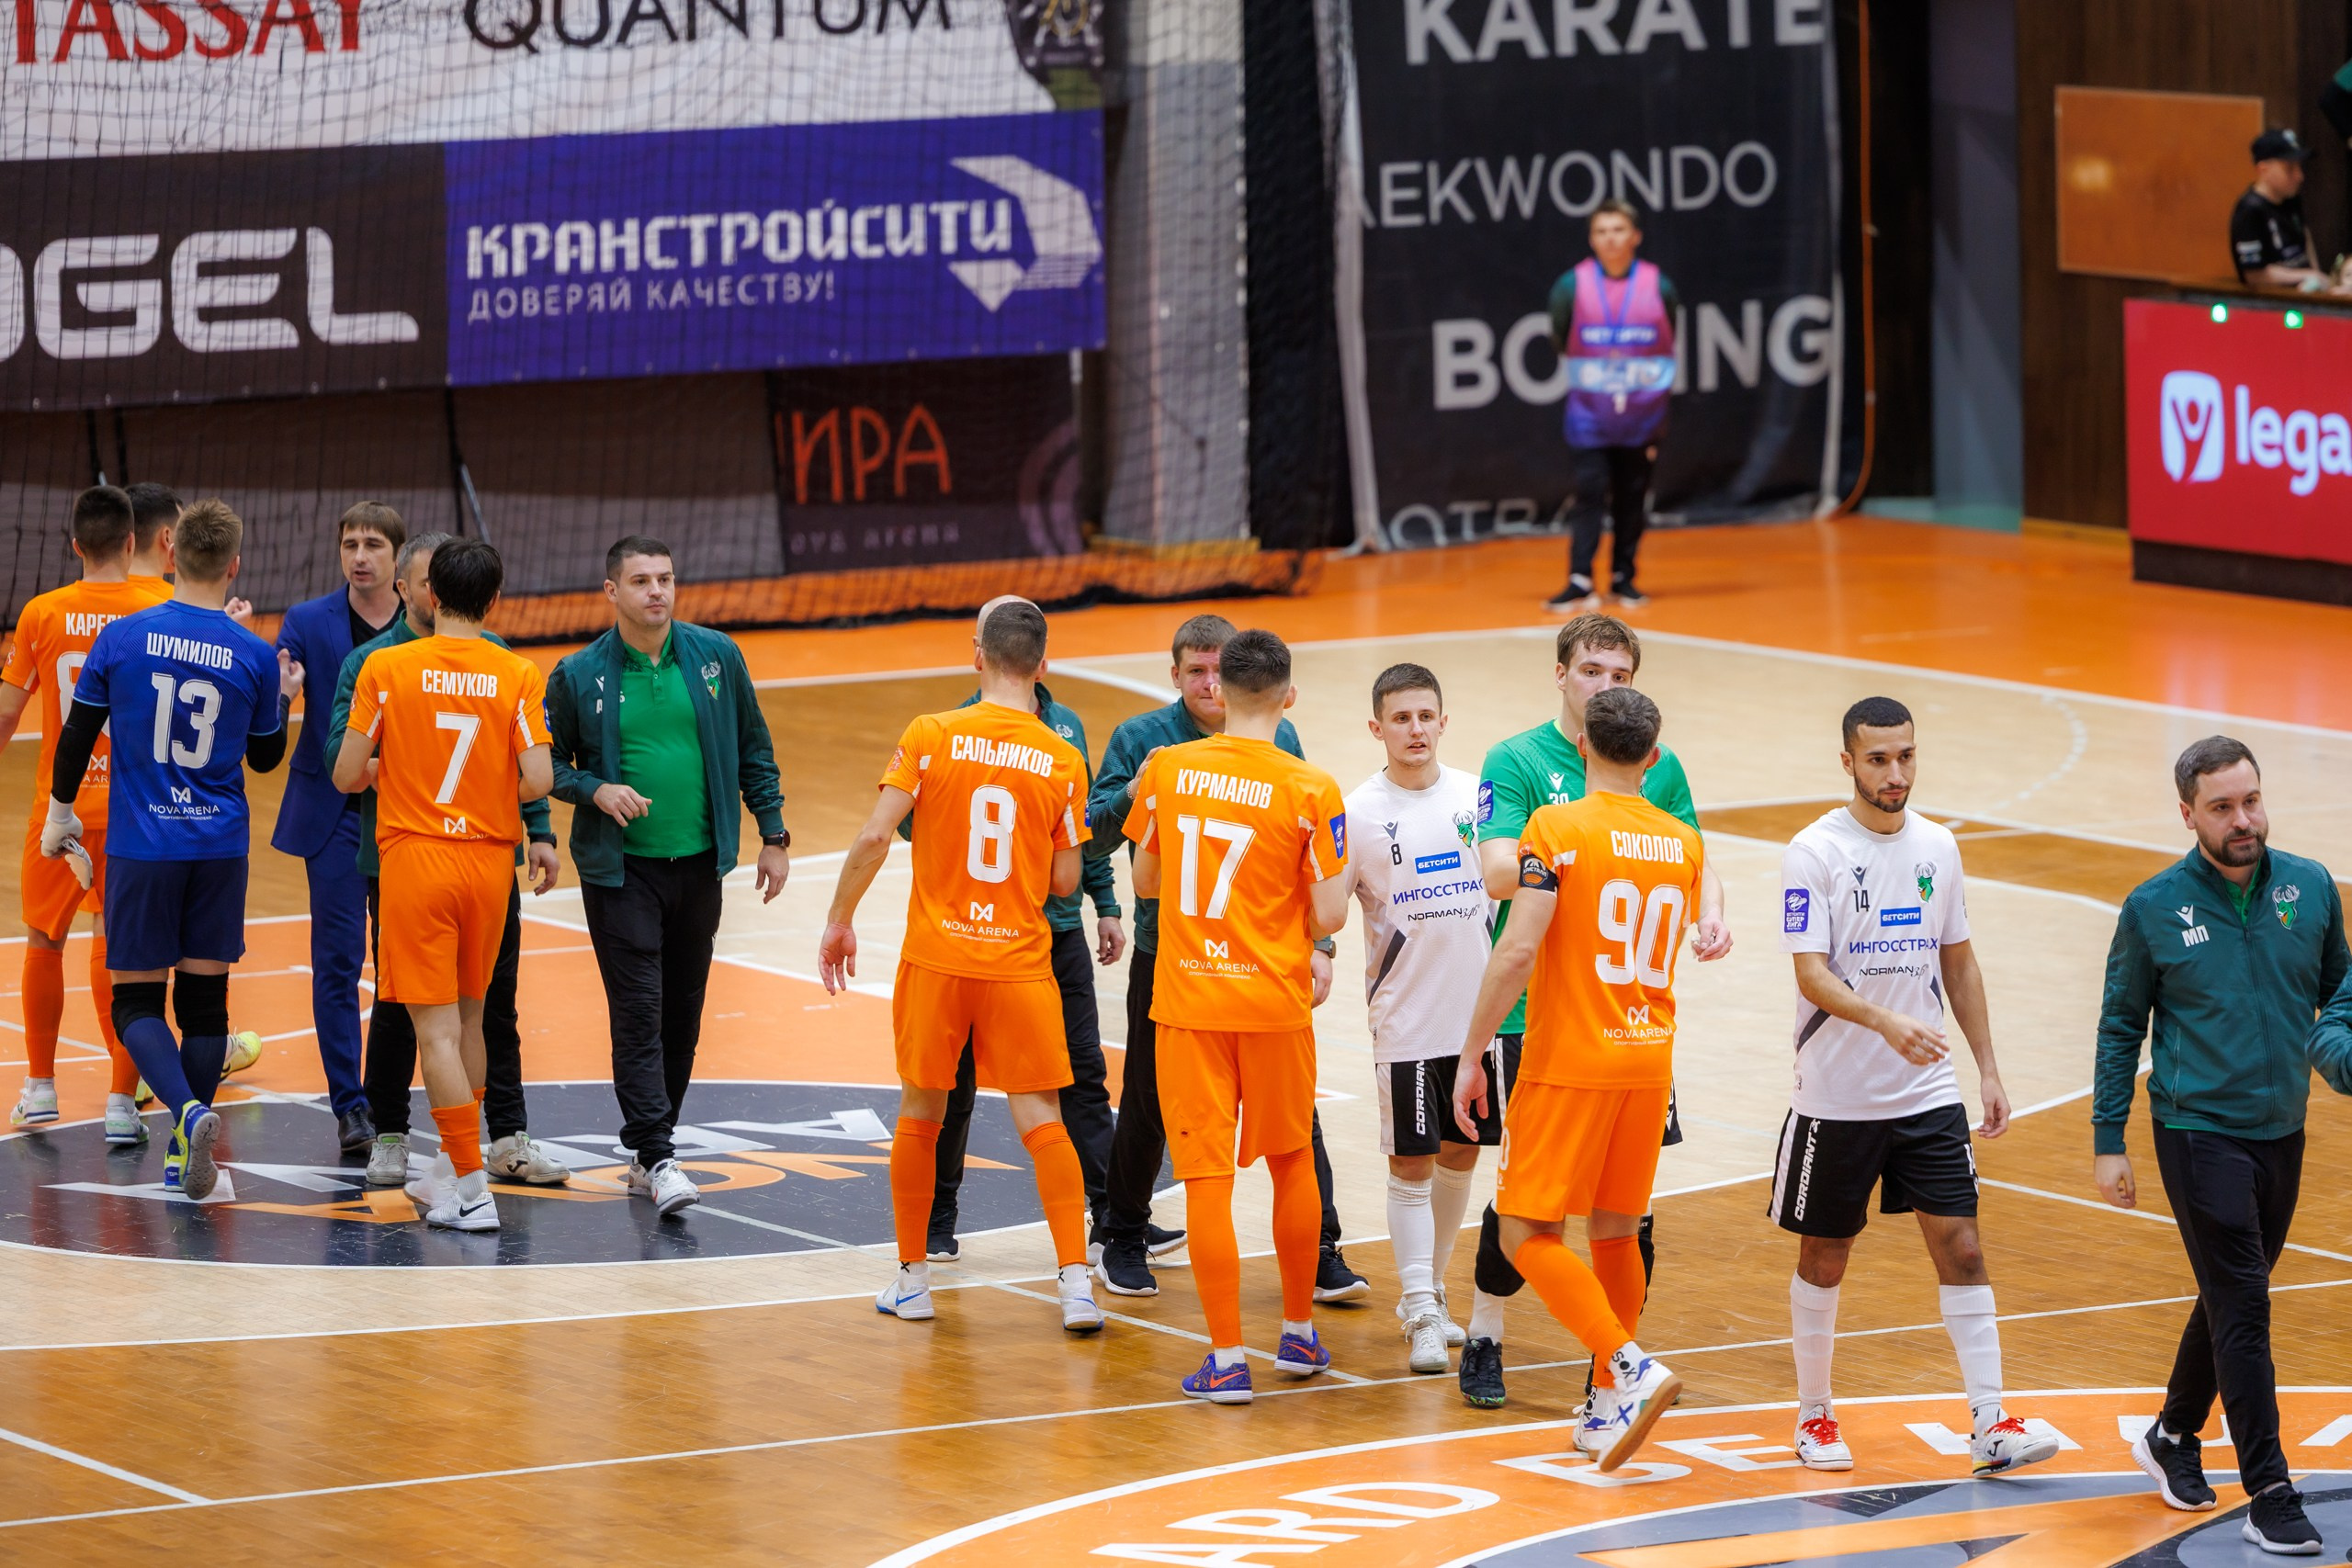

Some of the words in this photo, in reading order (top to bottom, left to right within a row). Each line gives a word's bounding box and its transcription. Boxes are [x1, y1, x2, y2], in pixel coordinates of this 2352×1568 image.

[1360, 141, 1778, 229] EKWONDO
[467, 199, 1012, 280] КРАНСТРОЙСИТИ
[0, 226, 420, 363] GEL
[468, 277, 633, 325] ДОВЕРЯЙ
[646, 272, 836, 310] КАЧЕСТВУ!
[1432, 295, 1833, 411] BOING
[775, 404, 952, 504] ИРА
[65, 613, 129, 637] КАРЕ
[146, 632, 233, 671] ШУМИЛОВ
[422, 669, 498, 698] СЕМУКОВ
[151, 671, 222, 770] 13
[435, 711, 482, 805] 7
[951, 734, 1054, 778] САЛЬНИКОВ
[149, 803, 181, 815] NOVA
[183, 805, 220, 815] ARENA
[1176, 768, 1273, 809] КУРМАНОВ
[967, 784, 1018, 884] 8
[1391, 843, 1402, 865] 8
[1611, 829, 1684, 864] СОКОЛОВ
[1177, 814, 1257, 919] 17
[1418, 856, 1458, 869] БЕТСИТИ
[1853, 889, 1871, 913] 14
[1882, 912, 1920, 921] БЕТСИТИ
[942, 919, 975, 933] NOVA
[978, 926, 1019, 938] ARENA
[1595, 878, 1686, 990] 90
[1179, 958, 1214, 970] NOVA
[1216, 962, 1260, 973] ARENA
[1603, 1028, 1638, 1039] NOVA
[1794, 1131, 1817, 1222] CORDIANT
